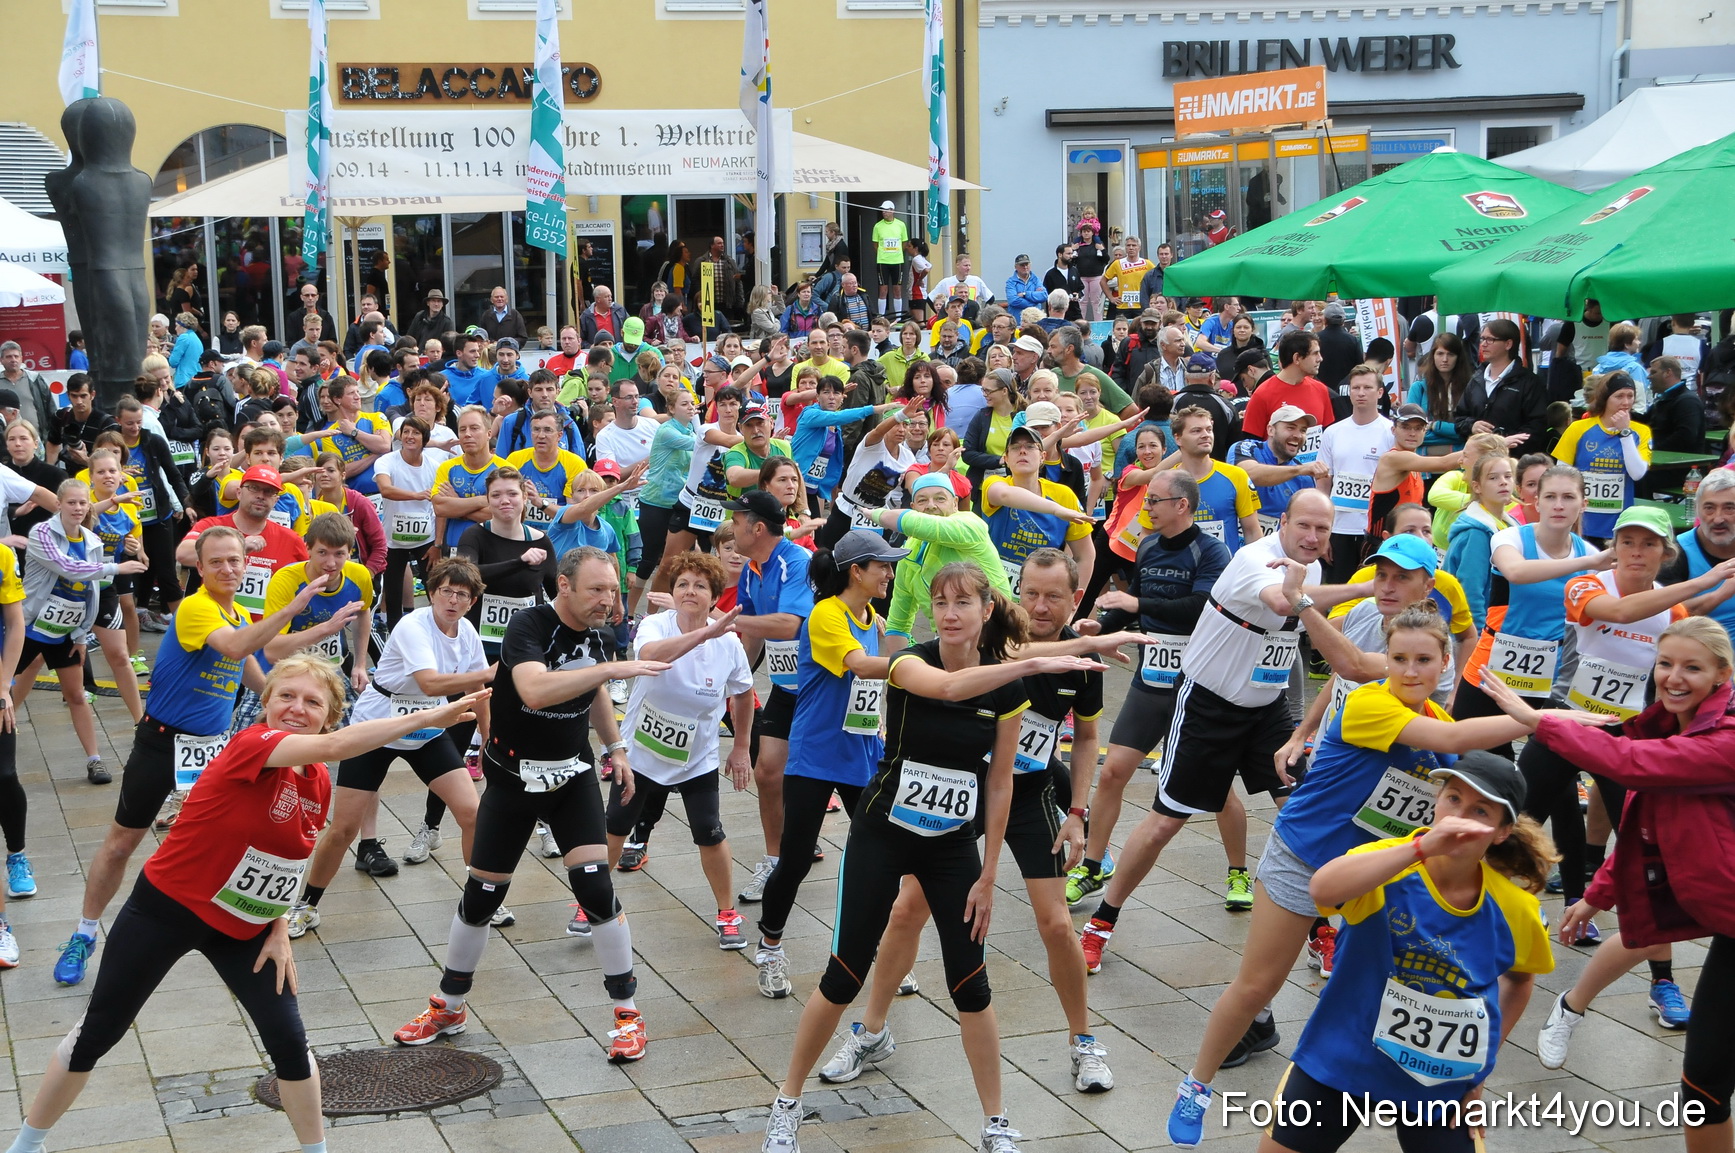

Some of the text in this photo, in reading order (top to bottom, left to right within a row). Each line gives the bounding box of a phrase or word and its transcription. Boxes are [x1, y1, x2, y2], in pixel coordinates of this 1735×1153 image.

[1319, 33, 1462, 72] WEBER
[1178, 83, 1317, 121] RUNMARKT.DE
[304, 127, 455, 152] usstellung
[473, 127, 515, 148] 100
[620, 127, 637, 147] 1.
[655, 124, 757, 147] Weltkrie
[331, 162, 390, 178] .09.14
[425, 161, 504, 178] 11.11.14
[564, 160, 672, 177] tadtmuseum
[682, 157, 756, 169] NEUMARKT
[793, 172, 861, 184] sbräu
[0, 252, 36, 263] Audi
[704, 281, 712, 313] A
[1123, 294, 1139, 302] 2318
[1336, 481, 1371, 498] 3332
[694, 503, 723, 520] 2061
[396, 520, 428, 534] 5107
[483, 597, 529, 607] PARTL Neumarkt
[44, 605, 82, 626] 5124
[490, 627, 506, 637] Mic
[1613, 629, 1655, 644] KLEBL
[1495, 637, 1548, 652] PARTL Neumarkt
[1149, 647, 1181, 669] 205
[1502, 649, 1545, 675] 242
[1582, 660, 1639, 680] PARTL Neumarkt
[853, 680, 872, 688] PARTL
[1505, 676, 1534, 689] Corina
[1591, 675, 1634, 705] 127
[855, 690, 881, 712] 52
[658, 714, 686, 729] Neumarkt
[641, 713, 688, 748] 5520
[1018, 727, 1050, 757] 47
[521, 765, 545, 773] PARTL
[1014, 757, 1031, 770] ard
[903, 767, 967, 786] PARTL Neumarkt
[1385, 773, 1411, 790] PARTL
[275, 799, 295, 813] NEU
[903, 780, 970, 817] 2448
[271, 808, 290, 819] MARKT
[918, 815, 943, 829] Ruth
[244, 852, 299, 874] PARTL Neumarkt
[236, 866, 298, 902] 5132
[234, 897, 275, 916] Theresia
[1391, 917, 1409, 928] Jahre
[1400, 970, 1444, 986] September
[1386, 988, 1474, 1019] PARTL Neumarkt
[1387, 1007, 1479, 1058] 2379
[1398, 1050, 1454, 1077] Daniela
